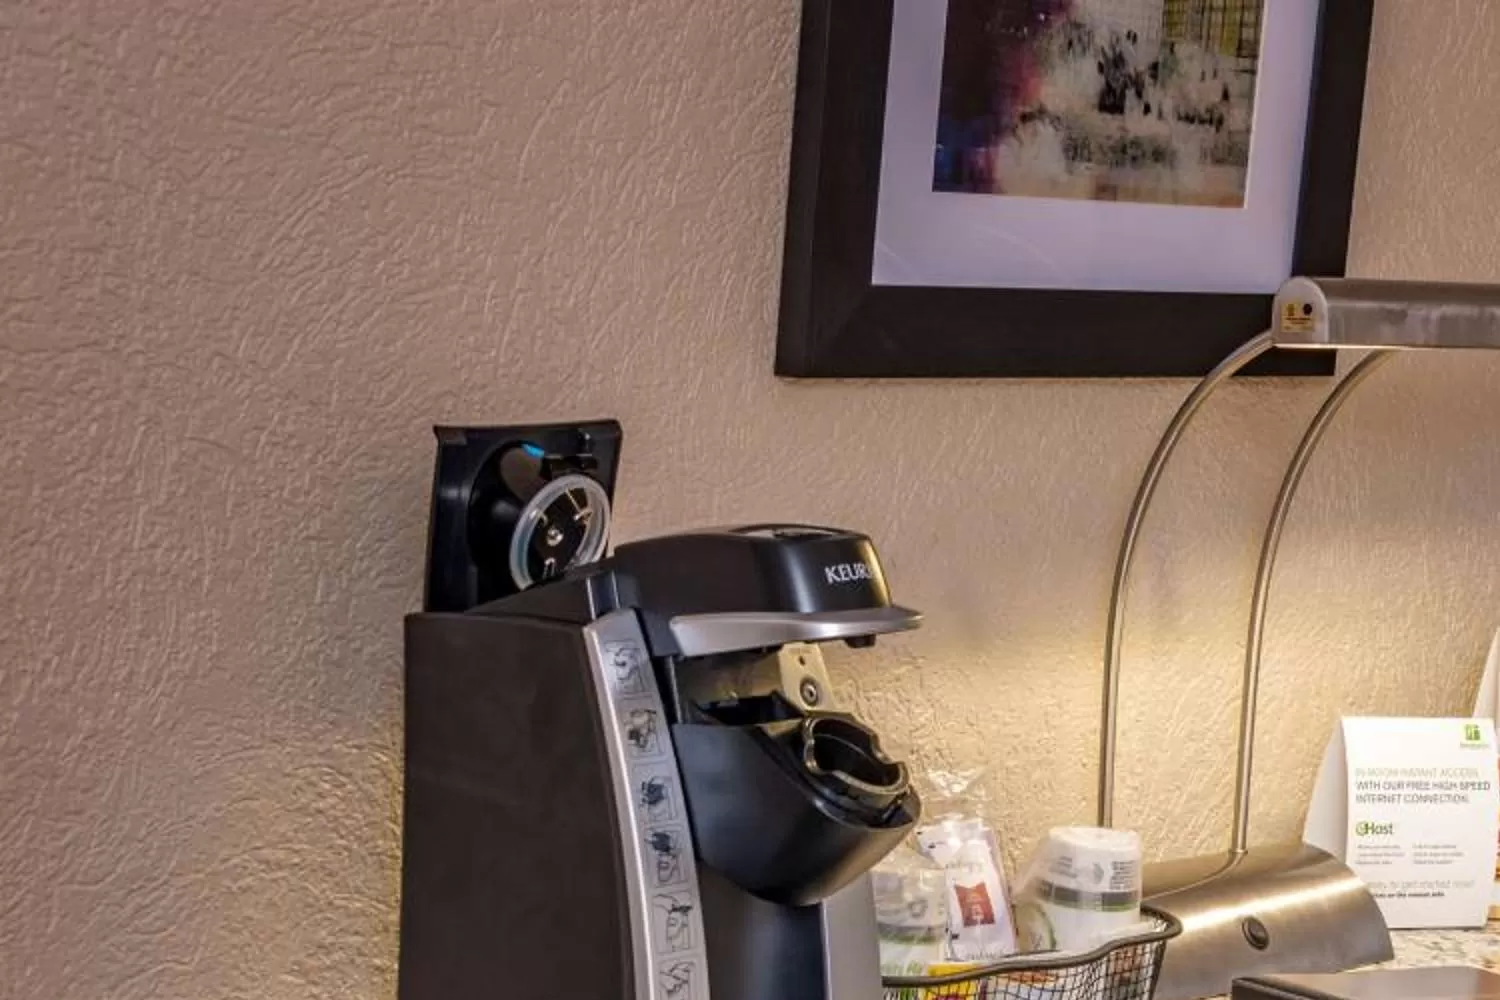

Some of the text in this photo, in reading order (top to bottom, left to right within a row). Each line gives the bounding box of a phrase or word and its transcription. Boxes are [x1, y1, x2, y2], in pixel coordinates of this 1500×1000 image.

[1356, 780, 1381, 791] WITH
[1382, 780, 1404, 791] OUR
[1405, 780, 1431, 791] FREE
[1355, 793, 1401, 804] INTERNET
